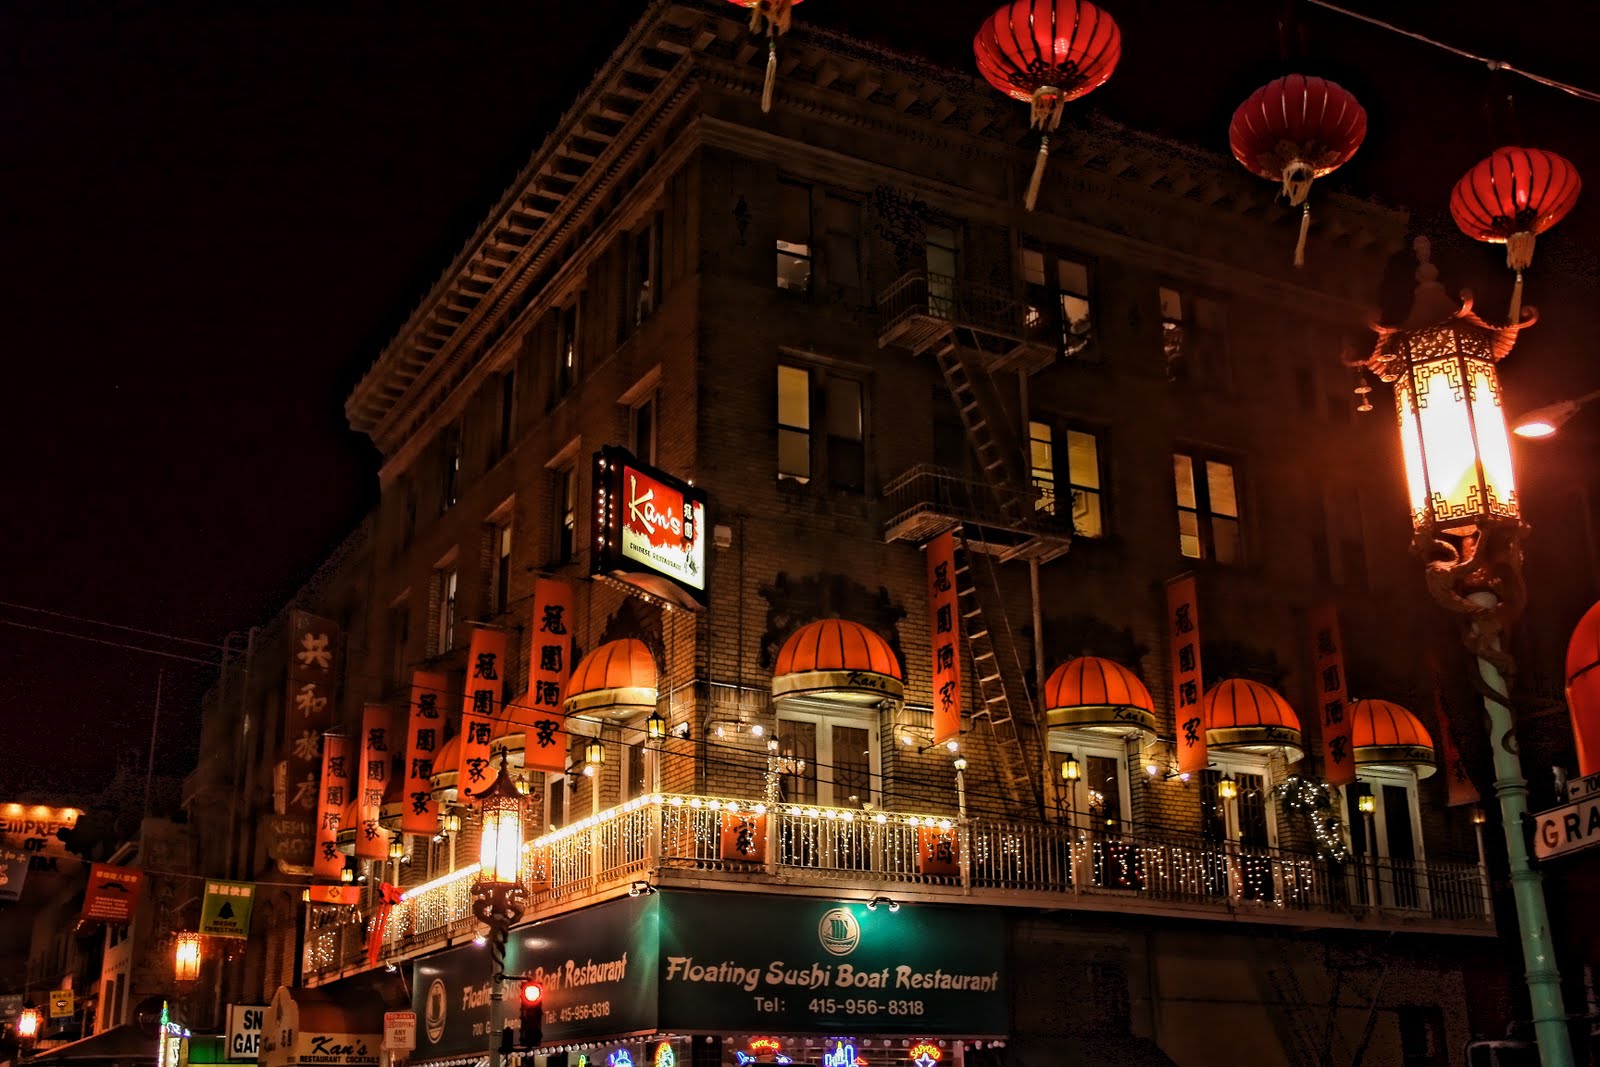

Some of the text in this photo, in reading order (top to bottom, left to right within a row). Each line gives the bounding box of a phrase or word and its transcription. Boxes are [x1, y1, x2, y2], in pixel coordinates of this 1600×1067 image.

[628, 474, 681, 536] Kan's
[847, 671, 886, 689] Kan's
[1583, 775, 1600, 793] 70
[0, 819, 59, 837] EMPRE
[1542, 806, 1600, 848] GRA
[24, 837, 48, 851] OF
[564, 952, 627, 989] Restaurant
[666, 956, 1000, 993] Floating Sushi Boat Restaurant
[560, 1001, 610, 1022] 415-956-8318
[754, 996, 924, 1016] Tel: 415-956-8318
[312, 1036, 368, 1055] Kan's
[910, 1045, 940, 1059] SAPPORO
[300, 1056, 341, 1064] RESTAURANT
